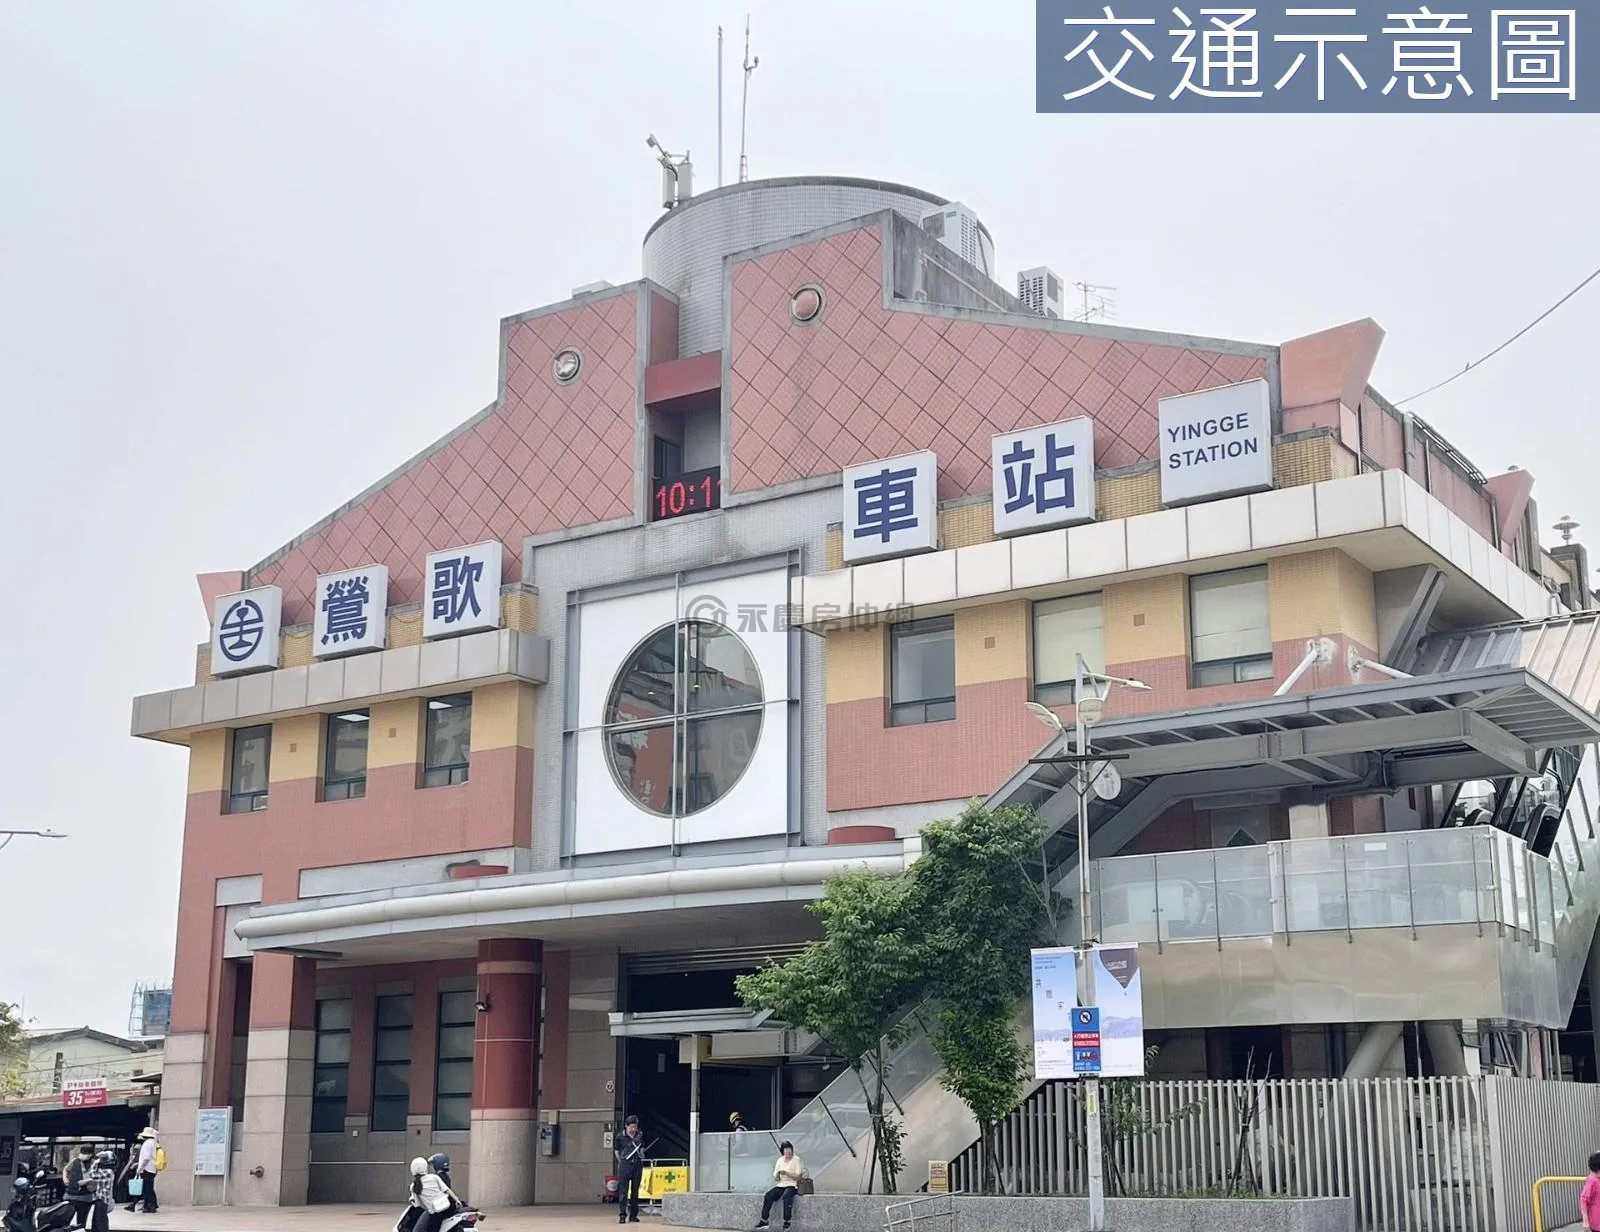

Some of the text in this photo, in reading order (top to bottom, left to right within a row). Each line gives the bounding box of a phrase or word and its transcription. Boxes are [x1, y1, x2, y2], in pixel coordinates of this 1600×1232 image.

[1167, 412, 1249, 443] YINGGE
[1169, 437, 1257, 469] STATION
[656, 475, 721, 517] 10:1
[67, 1090, 84, 1106] 35
